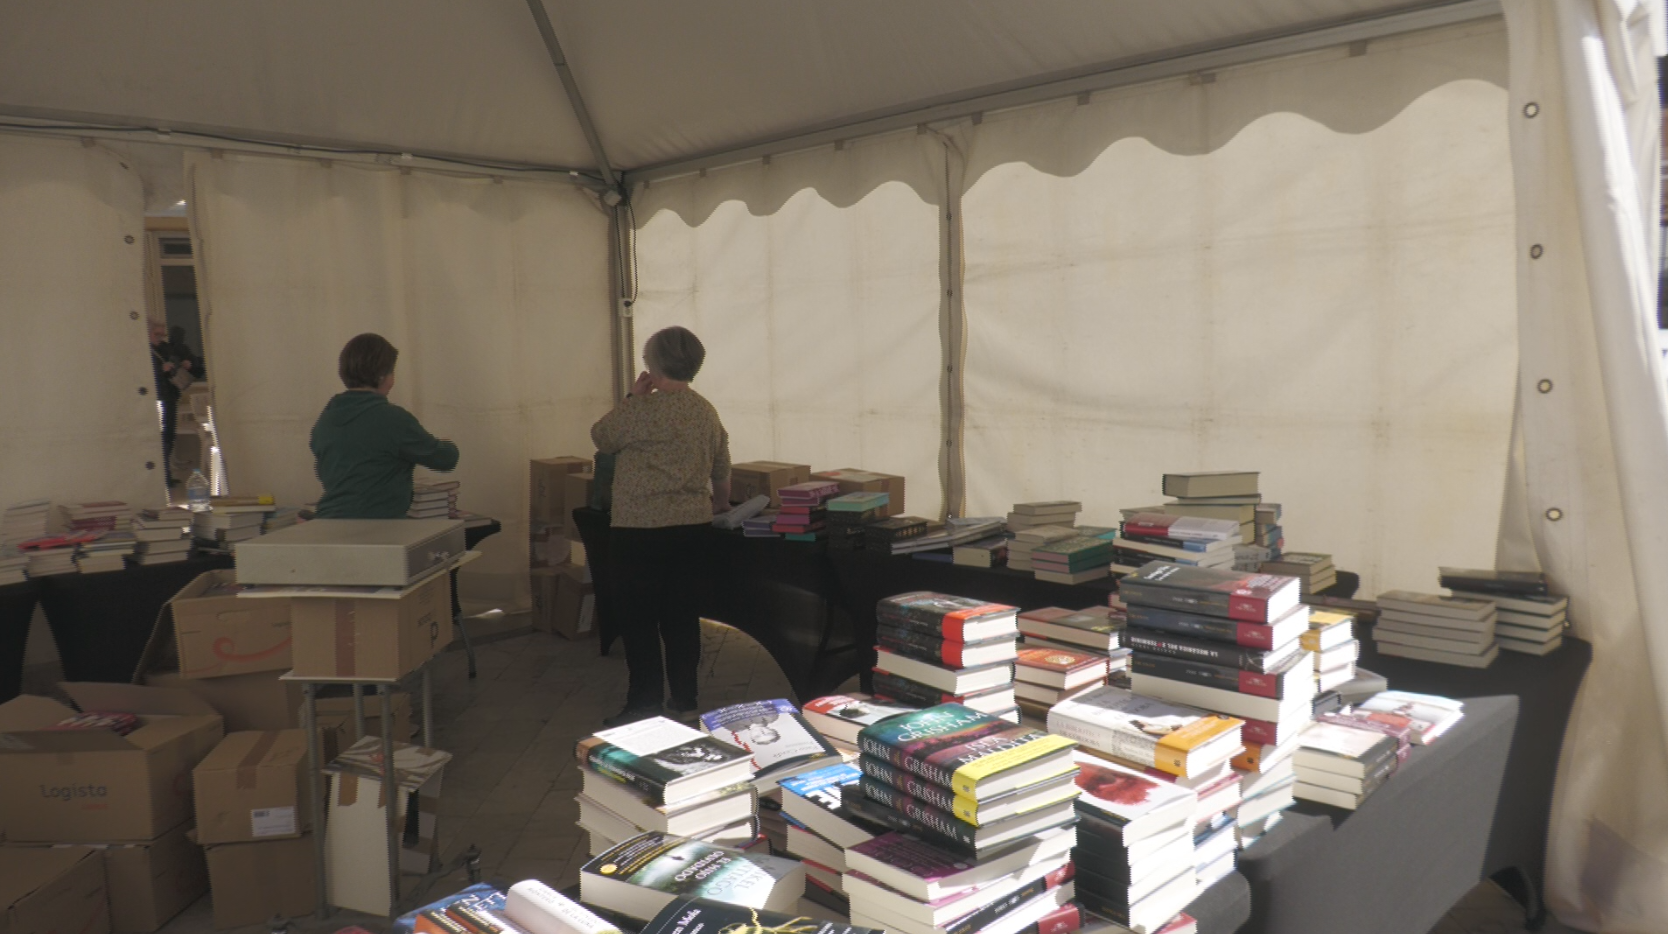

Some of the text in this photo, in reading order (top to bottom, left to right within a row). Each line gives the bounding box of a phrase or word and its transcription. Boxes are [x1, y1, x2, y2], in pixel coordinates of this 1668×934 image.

[897, 711, 989, 742] GRISHAM
[899, 711, 955, 733] JOHN
[863, 737, 891, 760] JOHN
[865, 761, 893, 784] JOHN
[40, 783, 108, 801] Logista
[865, 783, 893, 806] JOHN
[906, 804, 959, 841] GRISHAM
